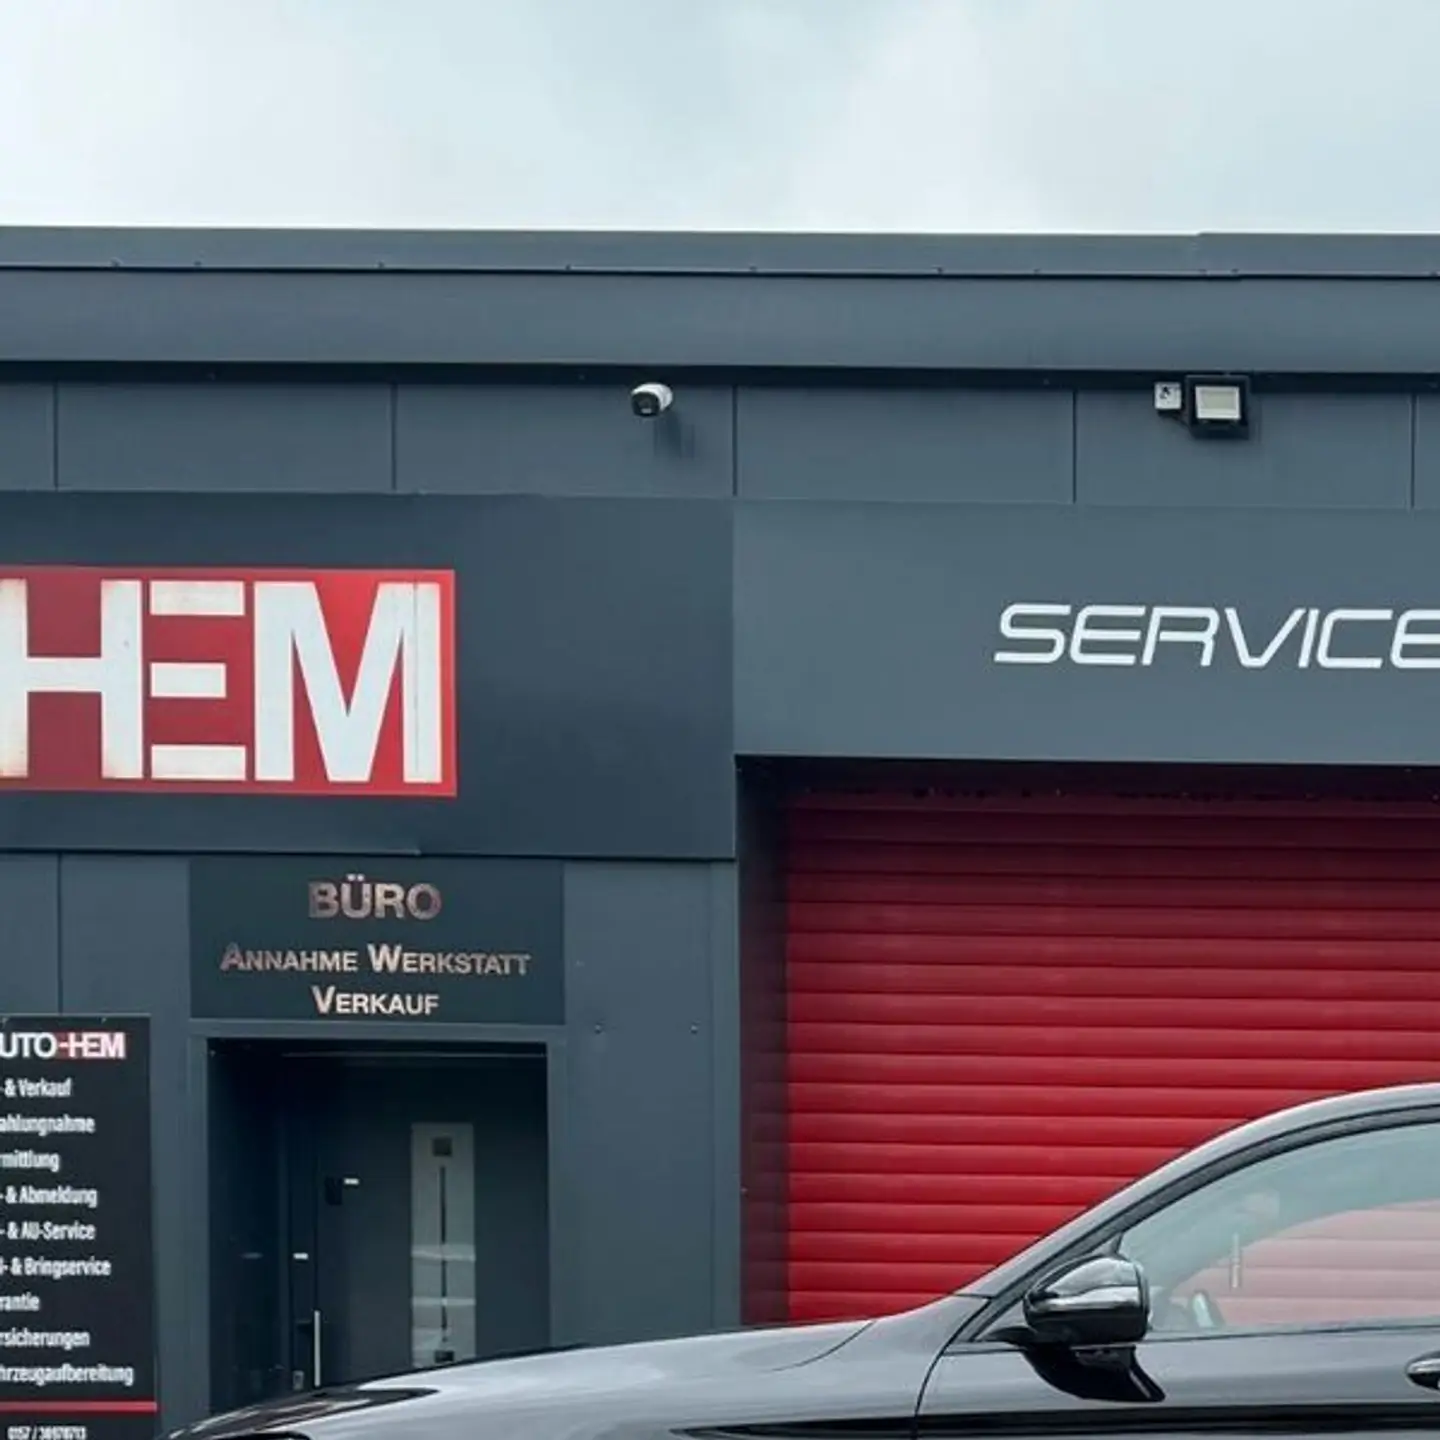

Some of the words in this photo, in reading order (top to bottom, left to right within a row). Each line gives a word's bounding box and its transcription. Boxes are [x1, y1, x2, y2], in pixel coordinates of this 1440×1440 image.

[0, 578, 442, 783] HEM
[308, 873, 442, 920] BÜRO
[219, 943, 359, 973] ANNAHME
[366, 943, 532, 976] WERKSTATT
[311, 985, 440, 1016] VERKAUF
[4, 1078, 17, 1097] &
[17, 1077, 72, 1098] Verkauf
[5, 1185, 18, 1204] &
[19, 1185, 98, 1208] Abmeldung
[7, 1221, 19, 1240] &
[21, 1220, 96, 1240] AU-Service
[11, 1257, 22, 1276] &
[24, 1255, 112, 1280] Bringservice
